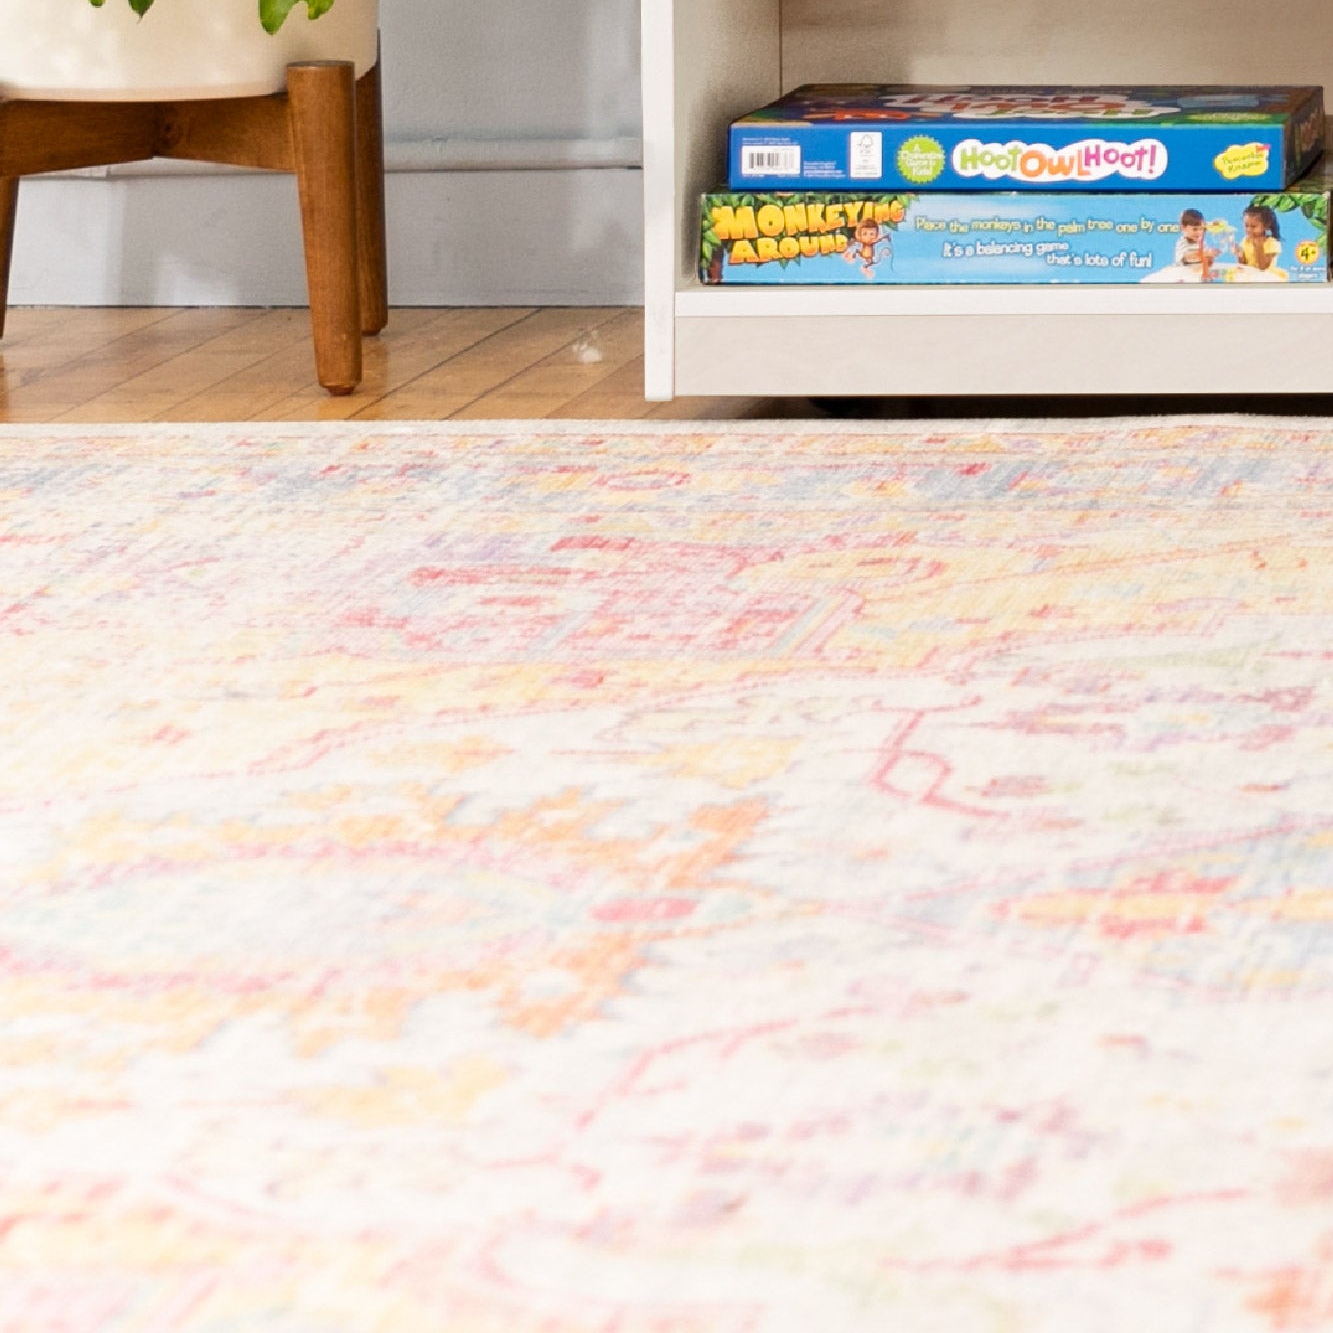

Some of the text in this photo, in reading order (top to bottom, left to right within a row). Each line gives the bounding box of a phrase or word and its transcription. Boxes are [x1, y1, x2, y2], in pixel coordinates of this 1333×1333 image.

[711, 200, 905, 240] MONKEYING
[971, 216, 1021, 233] monkeys
[1035, 217, 1055, 231] the
[1057, 221, 1086, 237] palm
[1087, 218, 1114, 231] tree
[1116, 223, 1138, 233] one
[1140, 216, 1155, 233] by
[728, 234, 849, 266] AROUND
[976, 239, 1033, 257] balancing
[1036, 241, 1069, 255] game
[1046, 252, 1083, 265] that's
[1085, 252, 1109, 266] lots
[1111, 251, 1128, 267] of
